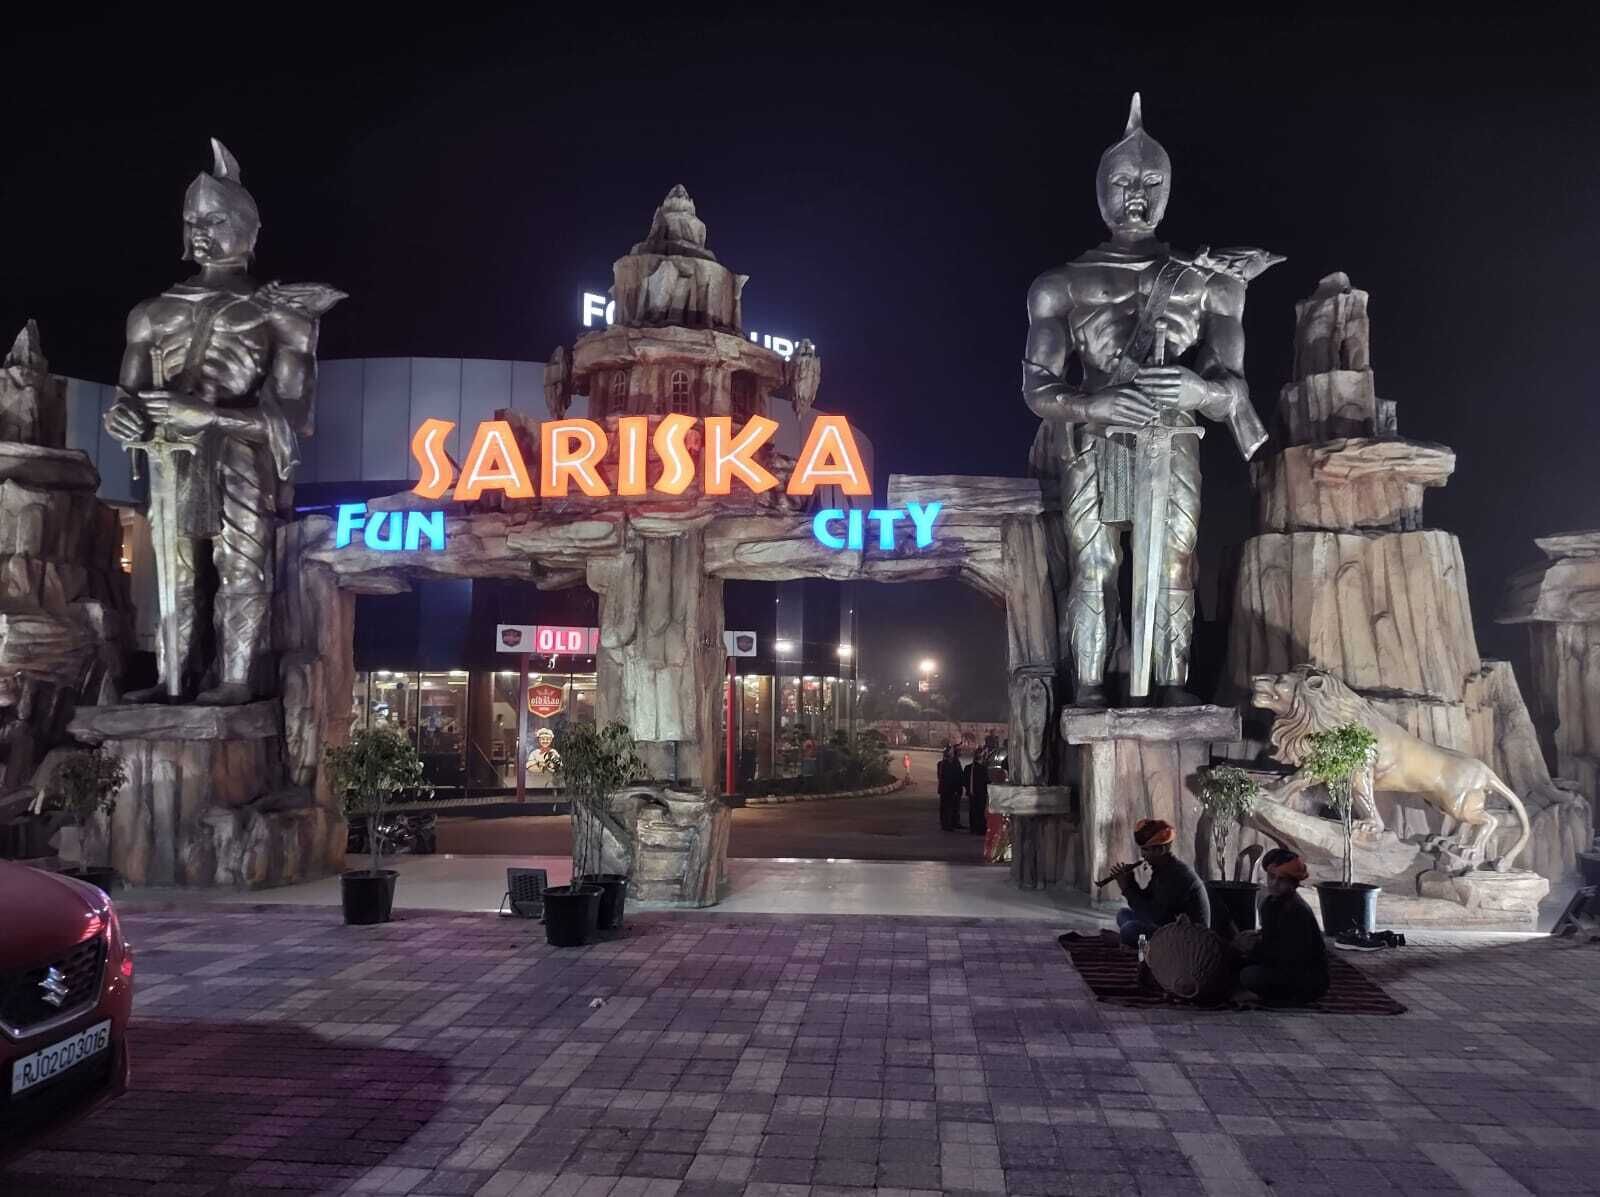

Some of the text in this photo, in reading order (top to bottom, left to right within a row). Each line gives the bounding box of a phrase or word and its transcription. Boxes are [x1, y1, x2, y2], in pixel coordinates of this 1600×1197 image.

[411, 413, 872, 501] SARISKA
[336, 502, 942, 551] FUN CITY
[539, 630, 581, 650] OLD
